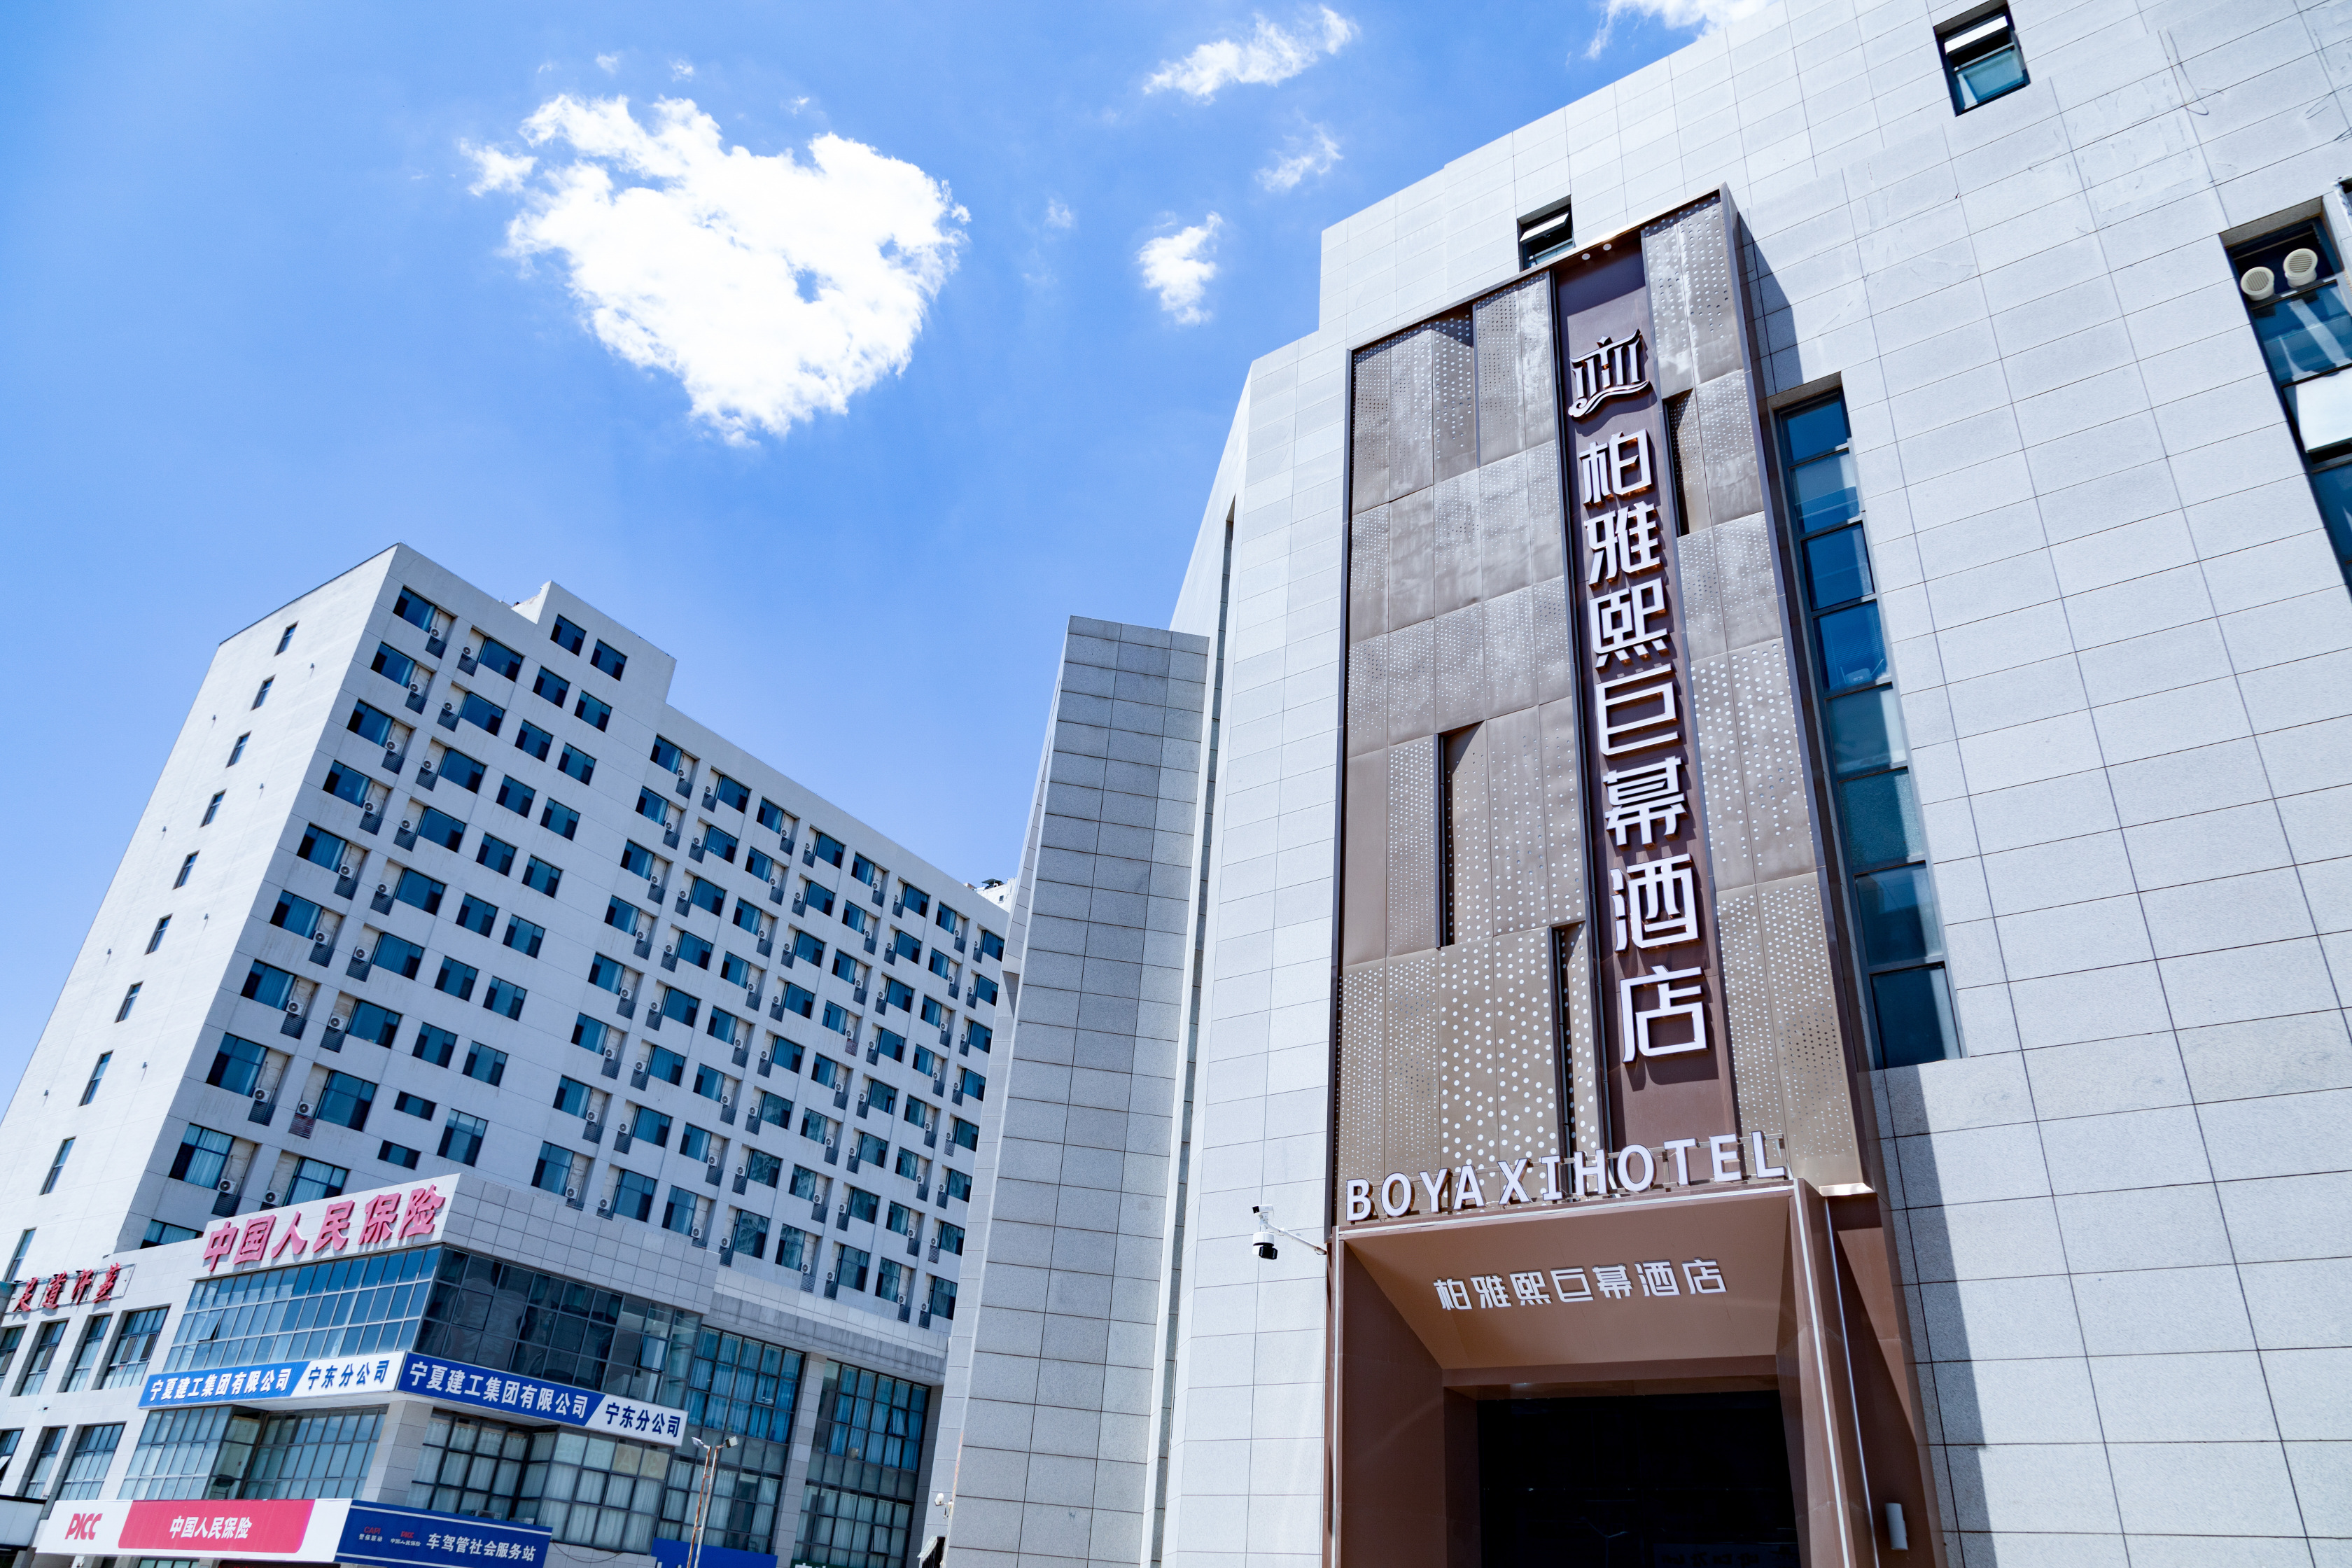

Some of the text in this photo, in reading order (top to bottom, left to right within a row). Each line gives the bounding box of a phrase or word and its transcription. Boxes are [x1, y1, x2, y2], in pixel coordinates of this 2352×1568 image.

[1579, 428, 1707, 1064] 柏雅熙巨幕酒店
[203, 1184, 446, 1272] 中国人民保险
[1434, 1257, 1727, 1310] 柏雅熙巨幕酒店
[150, 1360, 390, 1402] 宁夏建工集团有限公司 宁东分公司
[410, 1362, 681, 1438] 宁夏建工集团有限公司 宁东分公司
[65, 1513, 103, 1540] PICC
[169, 1515, 252, 1539] 中国人民保险
[426, 1533, 536, 1562] 车驾管社会服务站
